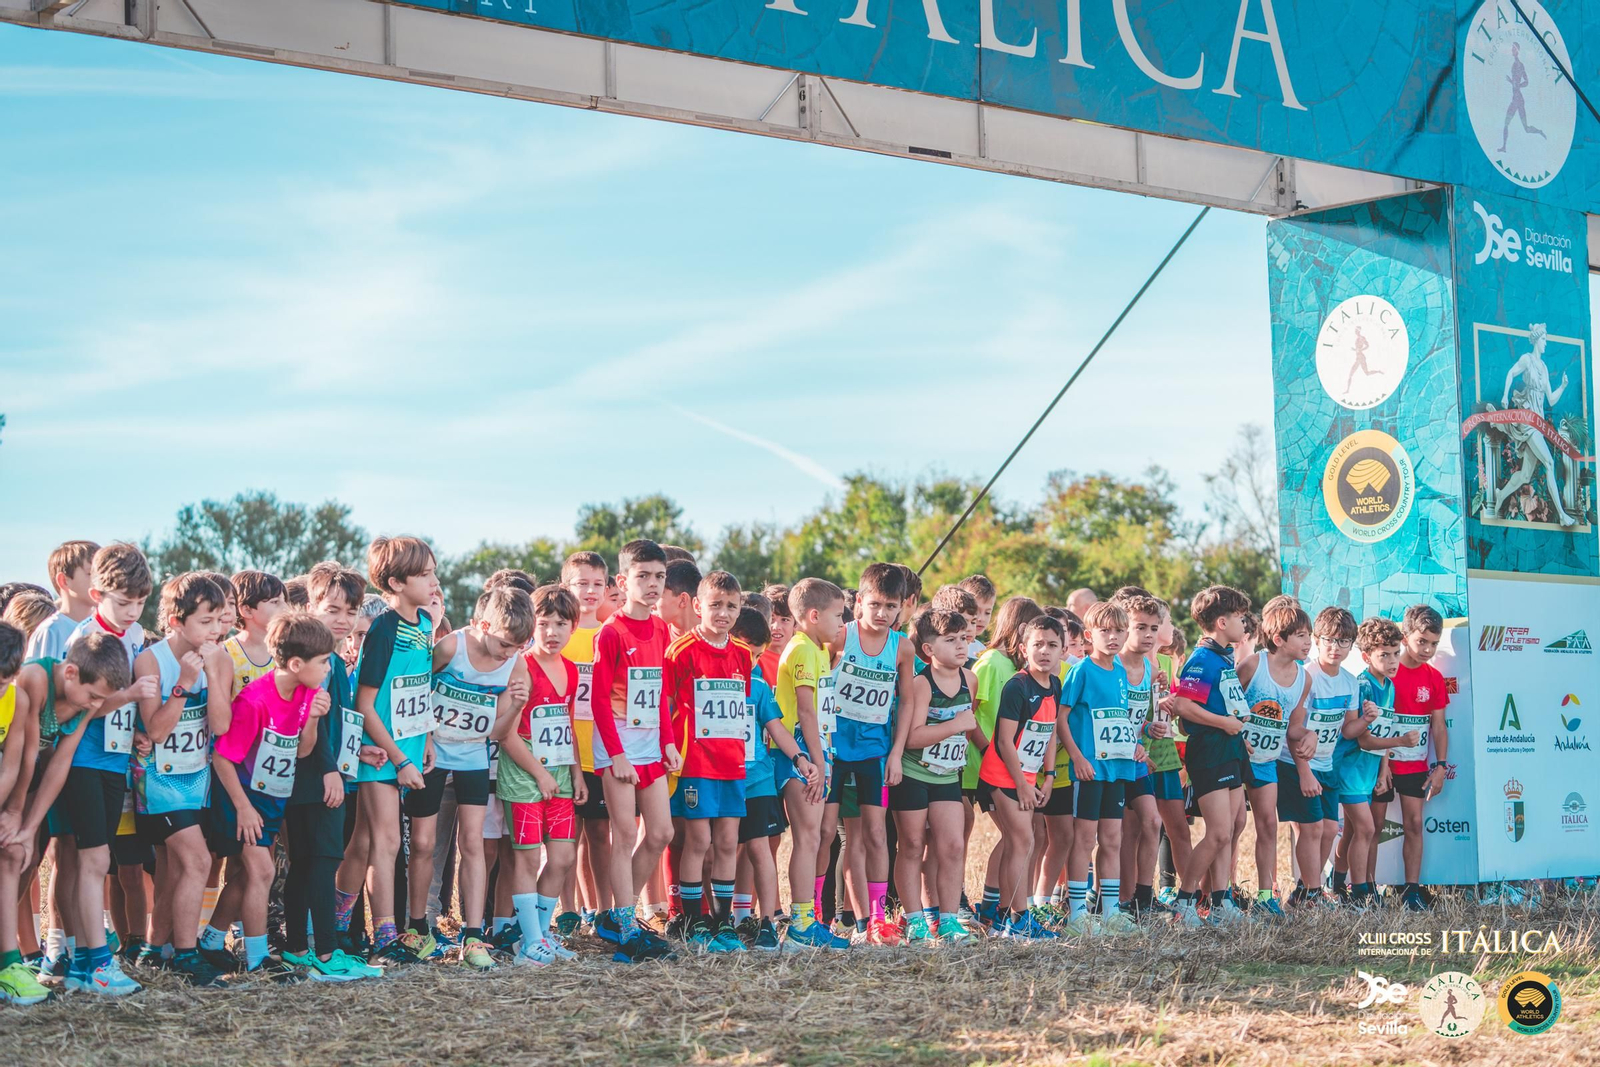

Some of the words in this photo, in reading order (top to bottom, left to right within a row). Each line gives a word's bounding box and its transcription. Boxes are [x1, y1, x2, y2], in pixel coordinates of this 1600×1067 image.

[1525, 227, 1572, 249] Diputación
[1525, 245, 1573, 274] Sevilla
[1463, 413, 1486, 435] CROSS
[1486, 410, 1535, 423] INTERNACIONAL
[1535, 417, 1547, 432] DE
[1328, 457, 1340, 481] GOLD
[1339, 439, 1359, 458] LEVEL
[1399, 458, 1409, 479] TOUR
[1350, 504, 1390, 515] ATHLETICS
[1356, 496, 1384, 506] WORLD
[1397, 482, 1411, 518] COUNTRY
[1352, 527, 1377, 537] WORLD
[1377, 518, 1398, 535] CROSS
[634, 689, 660, 709] 41
[839, 682, 890, 707] 4200
[433, 704, 490, 734] 4230
[702, 699, 745, 720] 4104
[539, 725, 573, 747] 420
[1100, 725, 1137, 744] 4233
[1486, 735, 1501, 743] Junta
[1502, 735, 1509, 743] de
[1510, 733, 1536, 743] Andalucía
[928, 742, 966, 761] 4103
[1023, 740, 1048, 757] 42
[261, 755, 297, 778] 42
[1424, 816, 1470, 833] Osten
[1561, 813, 1588, 824] ITÁLICA
